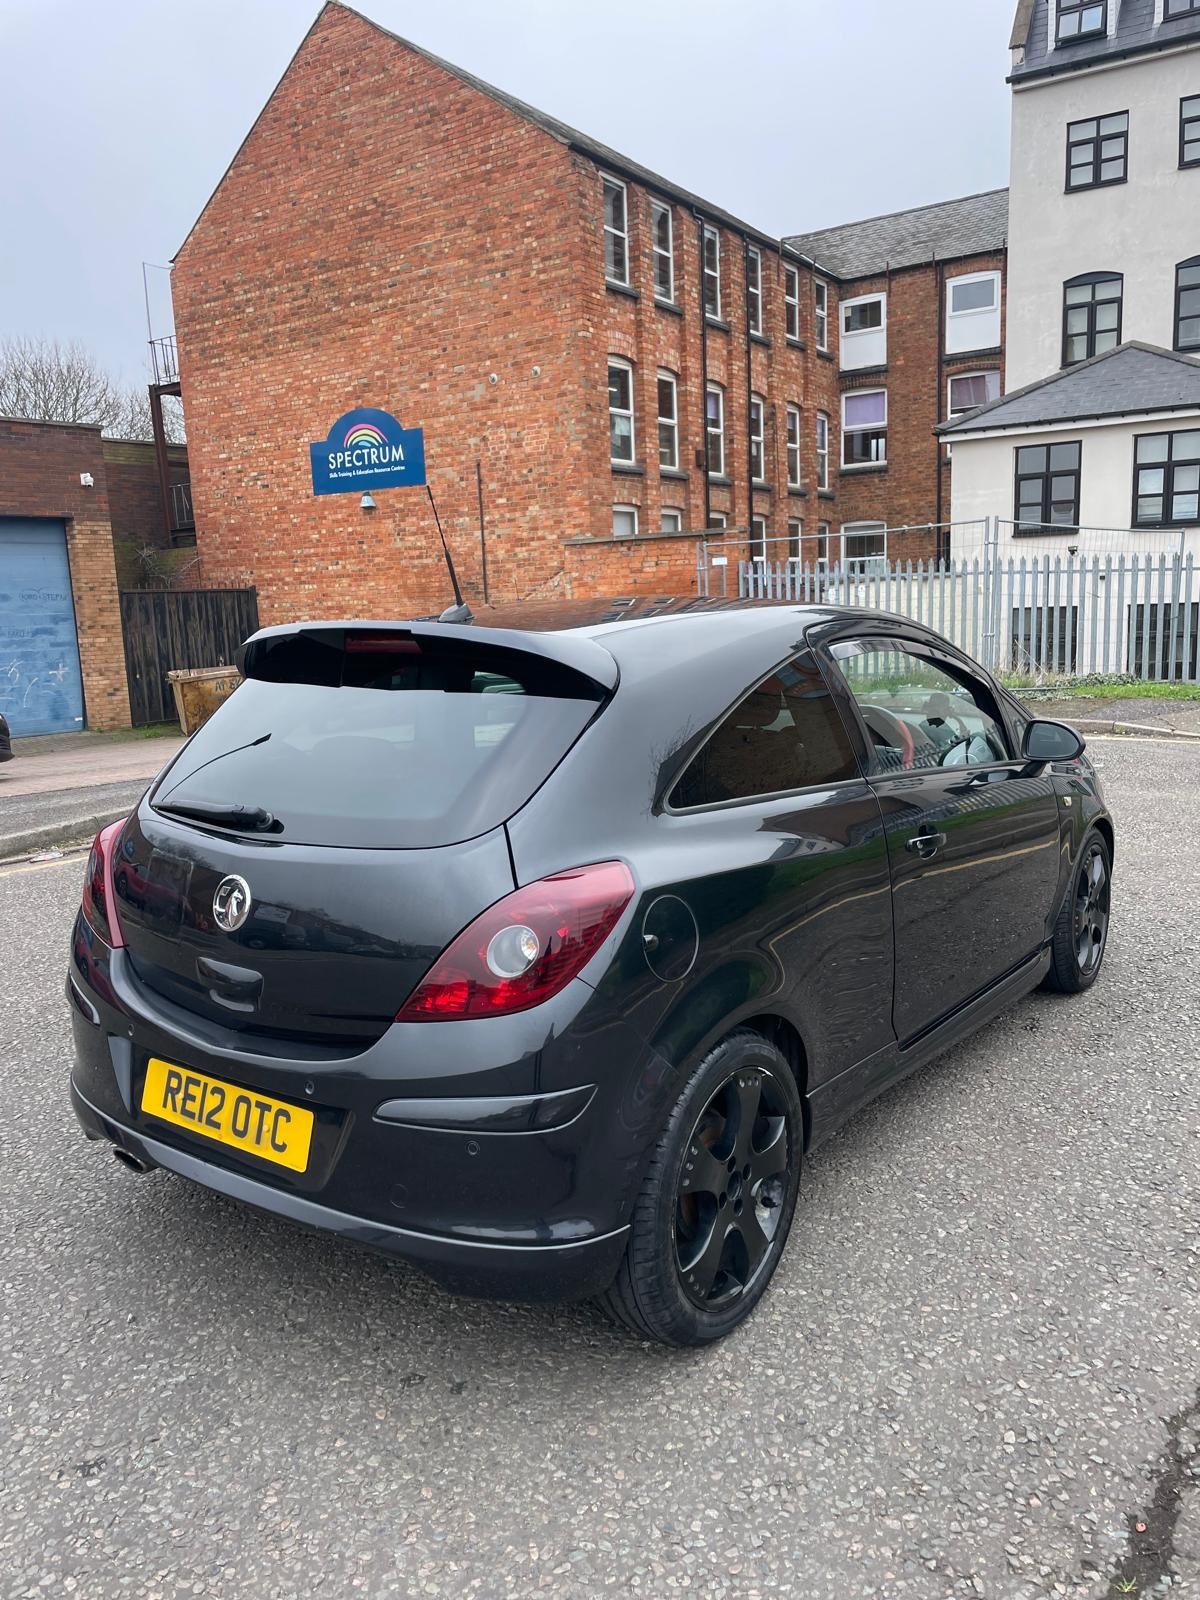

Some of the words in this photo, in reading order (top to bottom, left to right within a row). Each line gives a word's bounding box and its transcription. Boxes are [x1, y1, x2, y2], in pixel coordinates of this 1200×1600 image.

[328, 444, 404, 469] SPECTRUM
[162, 1069, 226, 1130] RE12
[231, 1095, 291, 1153] OTC
